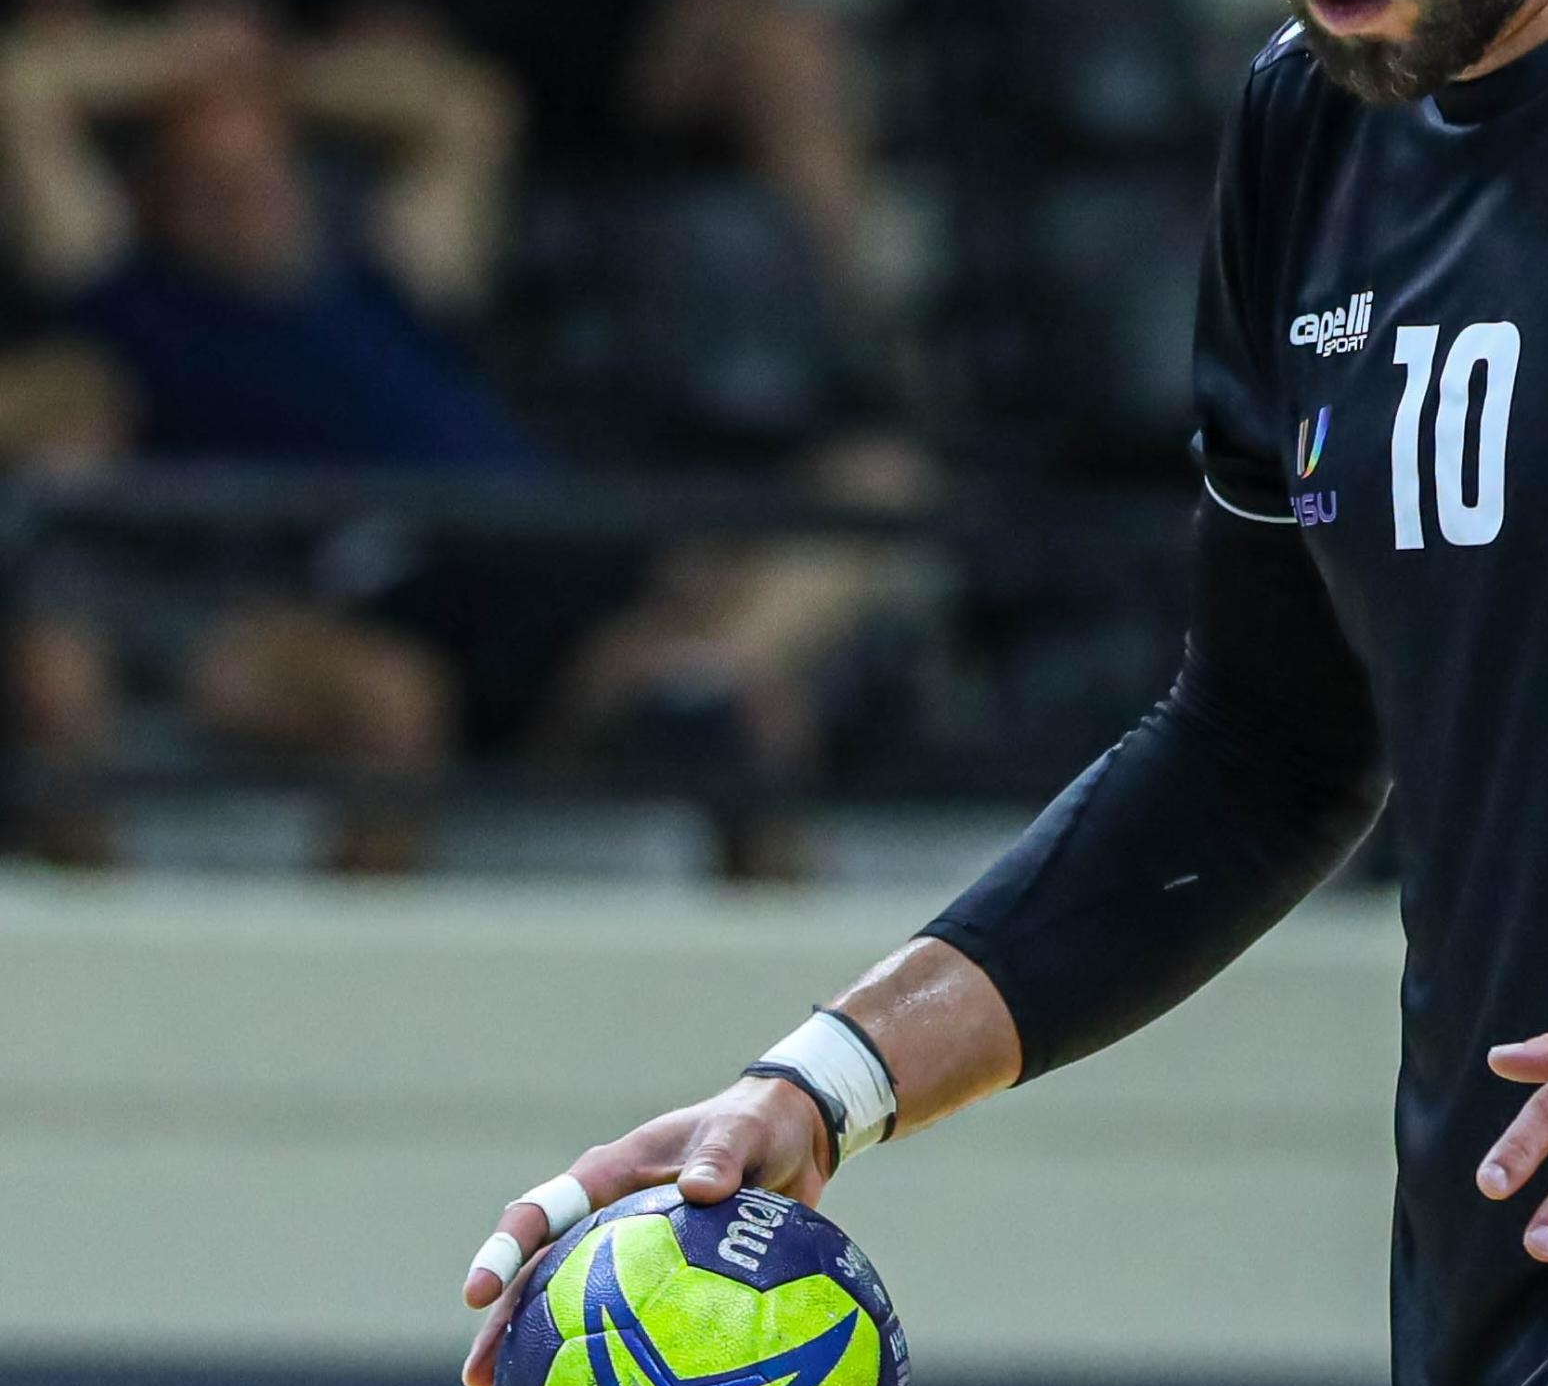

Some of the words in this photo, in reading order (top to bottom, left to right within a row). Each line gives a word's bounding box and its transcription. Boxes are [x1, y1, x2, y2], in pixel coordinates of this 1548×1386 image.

[1290, 291, 1374, 354] capelli
[1323, 334, 1368, 357] SPORT
[1392, 321, 1521, 549] 10
